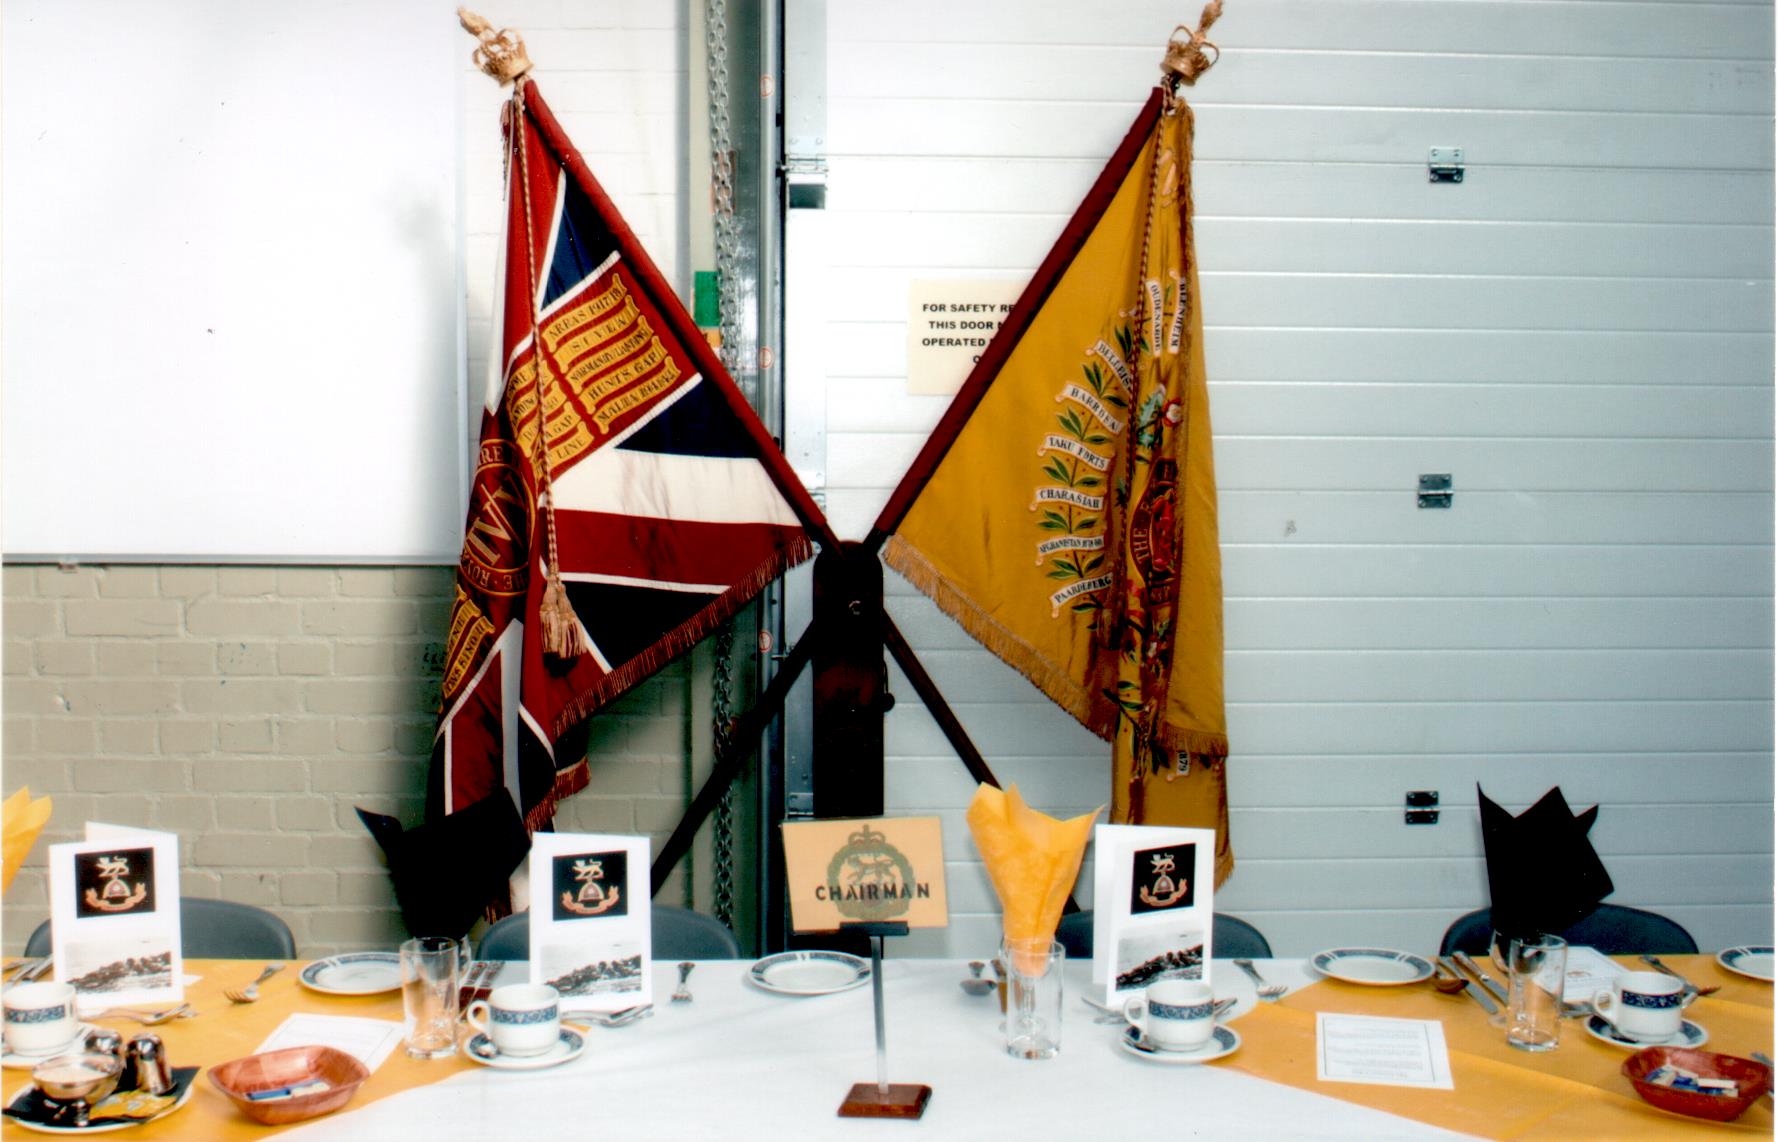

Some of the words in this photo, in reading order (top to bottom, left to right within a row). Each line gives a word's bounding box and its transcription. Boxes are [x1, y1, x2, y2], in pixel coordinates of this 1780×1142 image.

[922, 303, 947, 313] FOR
[950, 303, 997, 313] SAFETY
[1151, 284, 1161, 351] OUDENARDE
[928, 320, 957, 330] THIS
[960, 320, 994, 330] DOOR
[921, 338, 986, 347] OPERATED
[633, 351, 657, 373] GAP
[1049, 437, 1075, 450] TAKU
[1077, 446, 1106, 469] FORTS
[1039, 489, 1100, 508] CHARASIAH
[1132, 528, 1151, 564] THE
[1054, 576, 1112, 604] PAARDEBERG
[815, 883, 930, 901] CHAIRMAN
